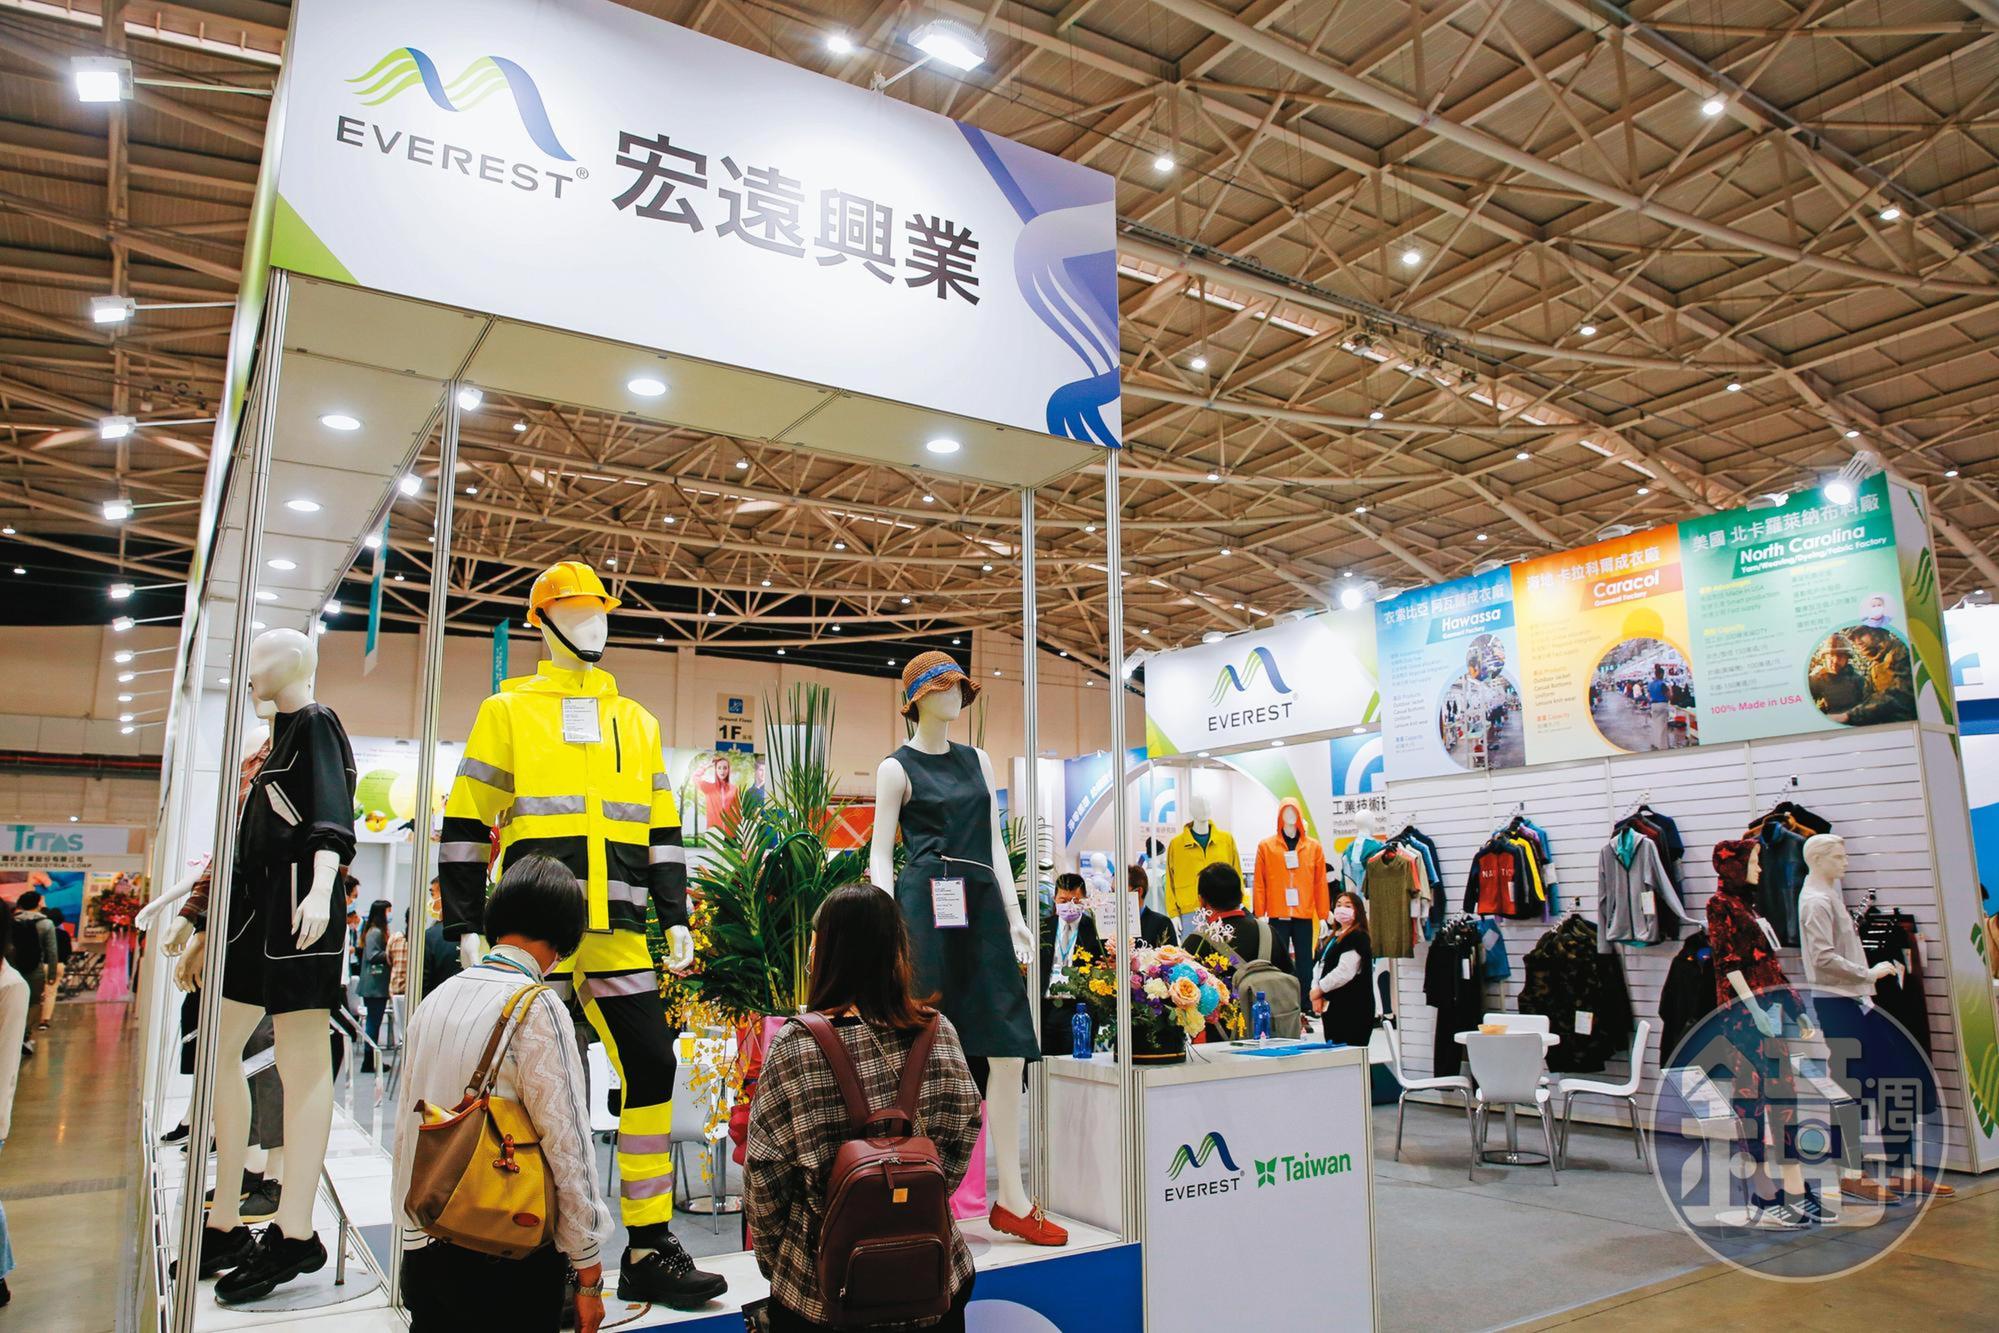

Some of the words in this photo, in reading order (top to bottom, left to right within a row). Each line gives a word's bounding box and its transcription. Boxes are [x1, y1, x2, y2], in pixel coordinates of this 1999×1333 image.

[336, 115, 573, 199] EVEREST
[611, 130, 980, 306] 宏遠興業
[1693, 530, 1726, 552] 美國
[1740, 542, 1785, 565] North
[1788, 526, 1866, 553] Carolina
[1855, 536, 1887, 551] Factory
[1593, 570, 1660, 597] Caracol
[1442, 608, 1501, 632] Hawassa
[1208, 702, 1292, 732] EVEREST
[1711, 703, 1737, 715] 100%
[1738, 700, 1766, 712] Made
[1768, 699, 1778, 707] in
[1780, 694, 1803, 705] USA
[719, 725, 742, 740] 1F
[1281, 1151, 1352, 1182] Taiwan
[1165, 1177, 1240, 1202] EVEREST
